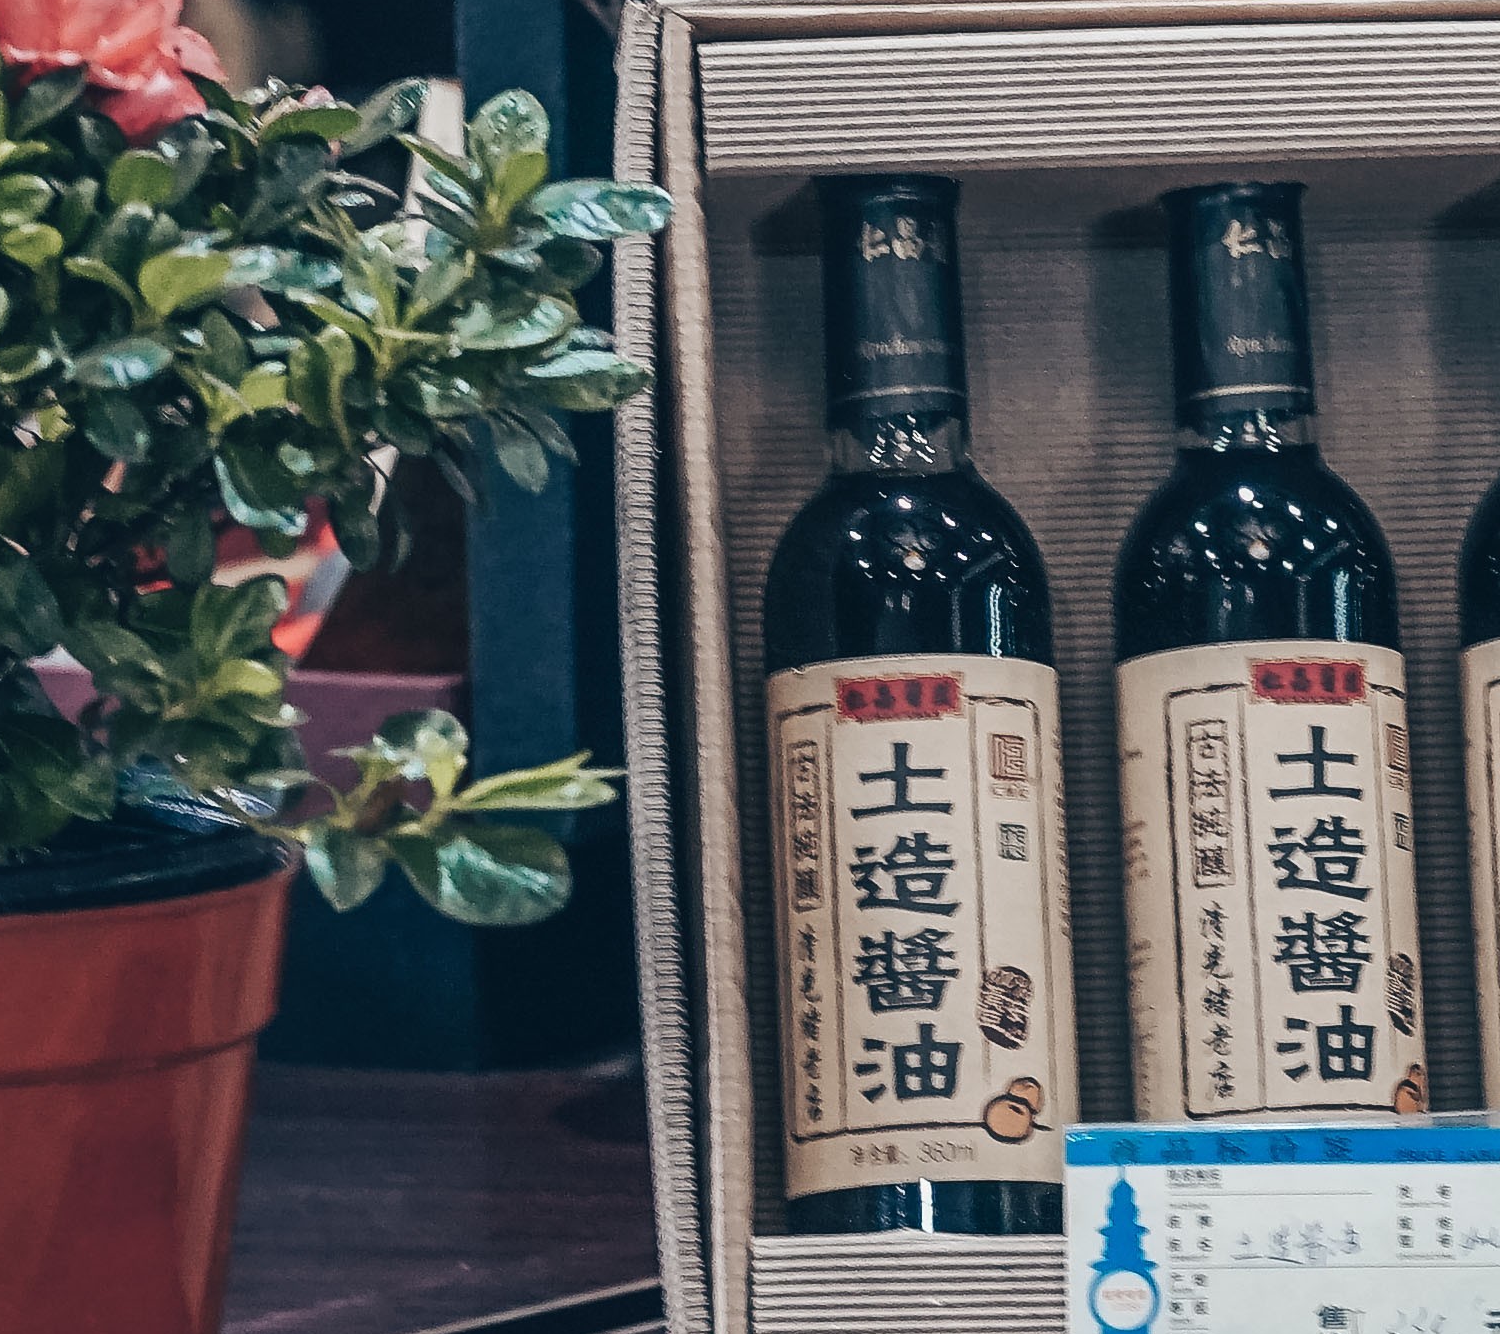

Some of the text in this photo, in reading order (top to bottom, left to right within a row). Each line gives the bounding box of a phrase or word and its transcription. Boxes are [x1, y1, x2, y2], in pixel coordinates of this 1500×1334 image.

[851, 742, 961, 1102] 土造醬油
[1267, 725, 1374, 1082] 土造醬油
